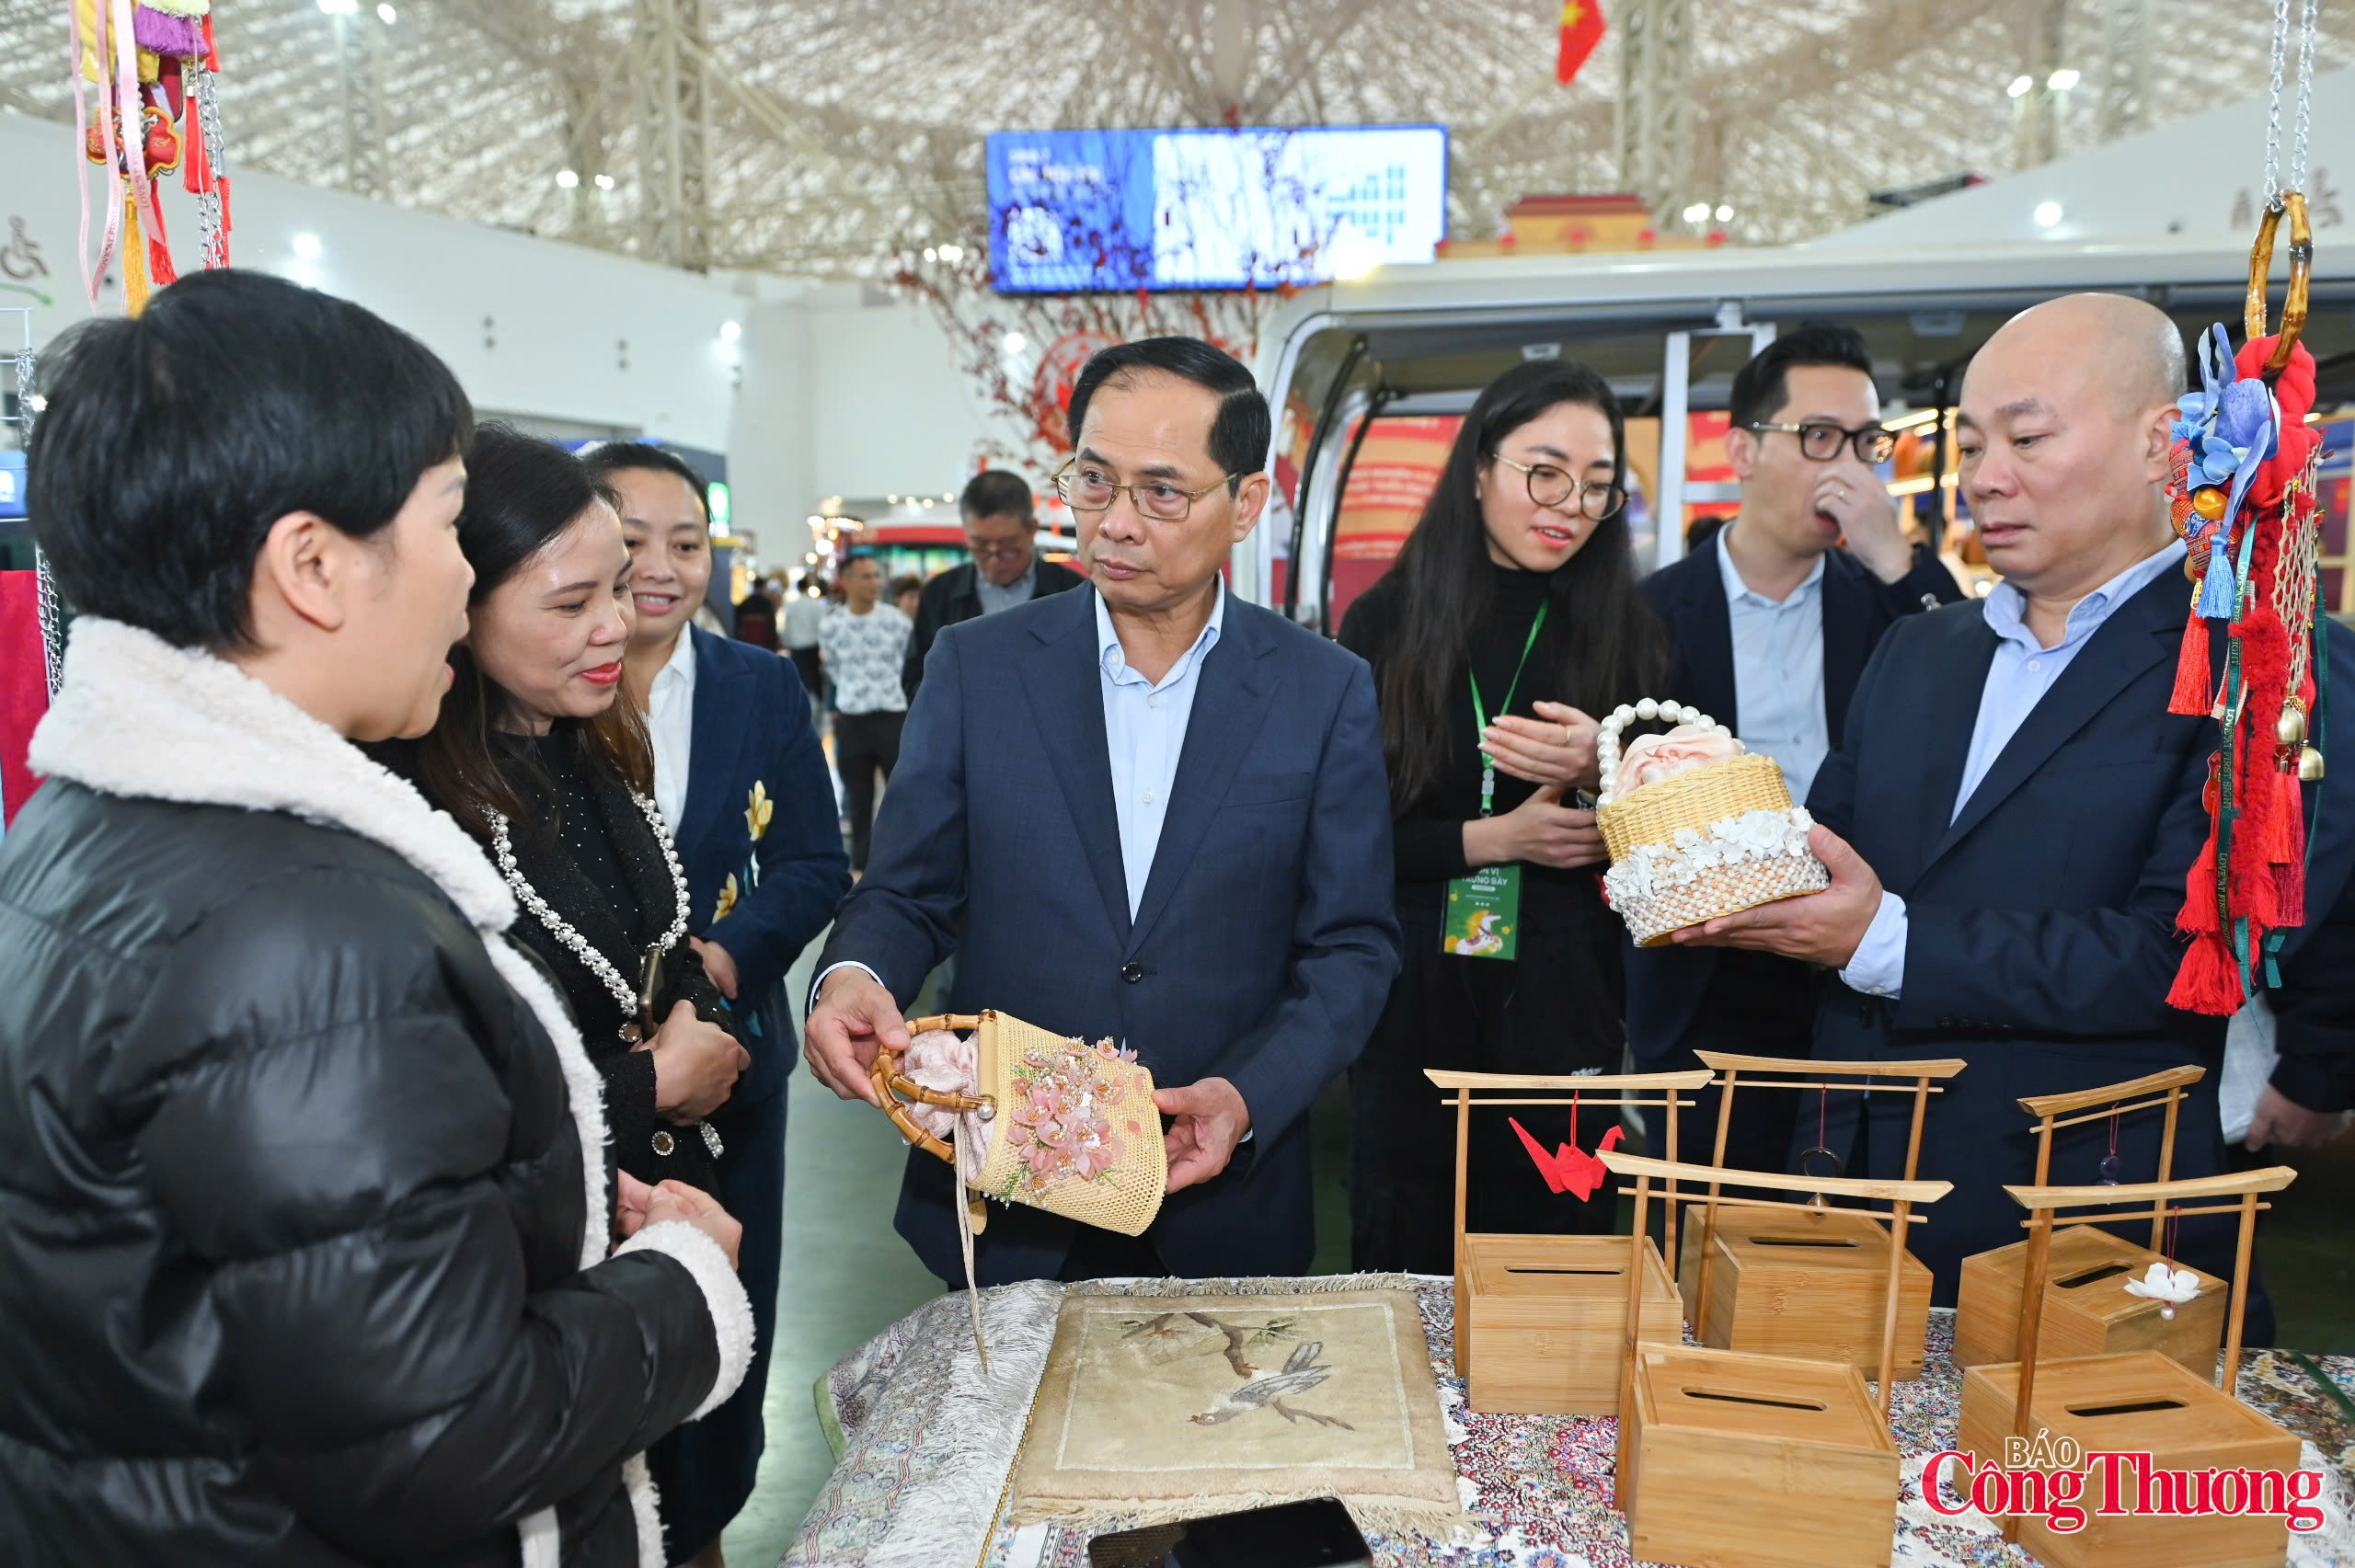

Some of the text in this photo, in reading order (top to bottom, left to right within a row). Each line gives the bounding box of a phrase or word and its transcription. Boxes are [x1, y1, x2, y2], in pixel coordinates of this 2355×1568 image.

[2236, 561, 2248, 587] LOVE
[2234, 589, 2243, 602] AT
[2233, 604, 2241, 624] FIR
[2223, 708, 2235, 810] LOVE AT FIRST SIGHT
[2218, 853, 2228, 878] LOVE
[2217, 880, 2225, 893] AT
[2218, 894, 2227, 920] FIRST
